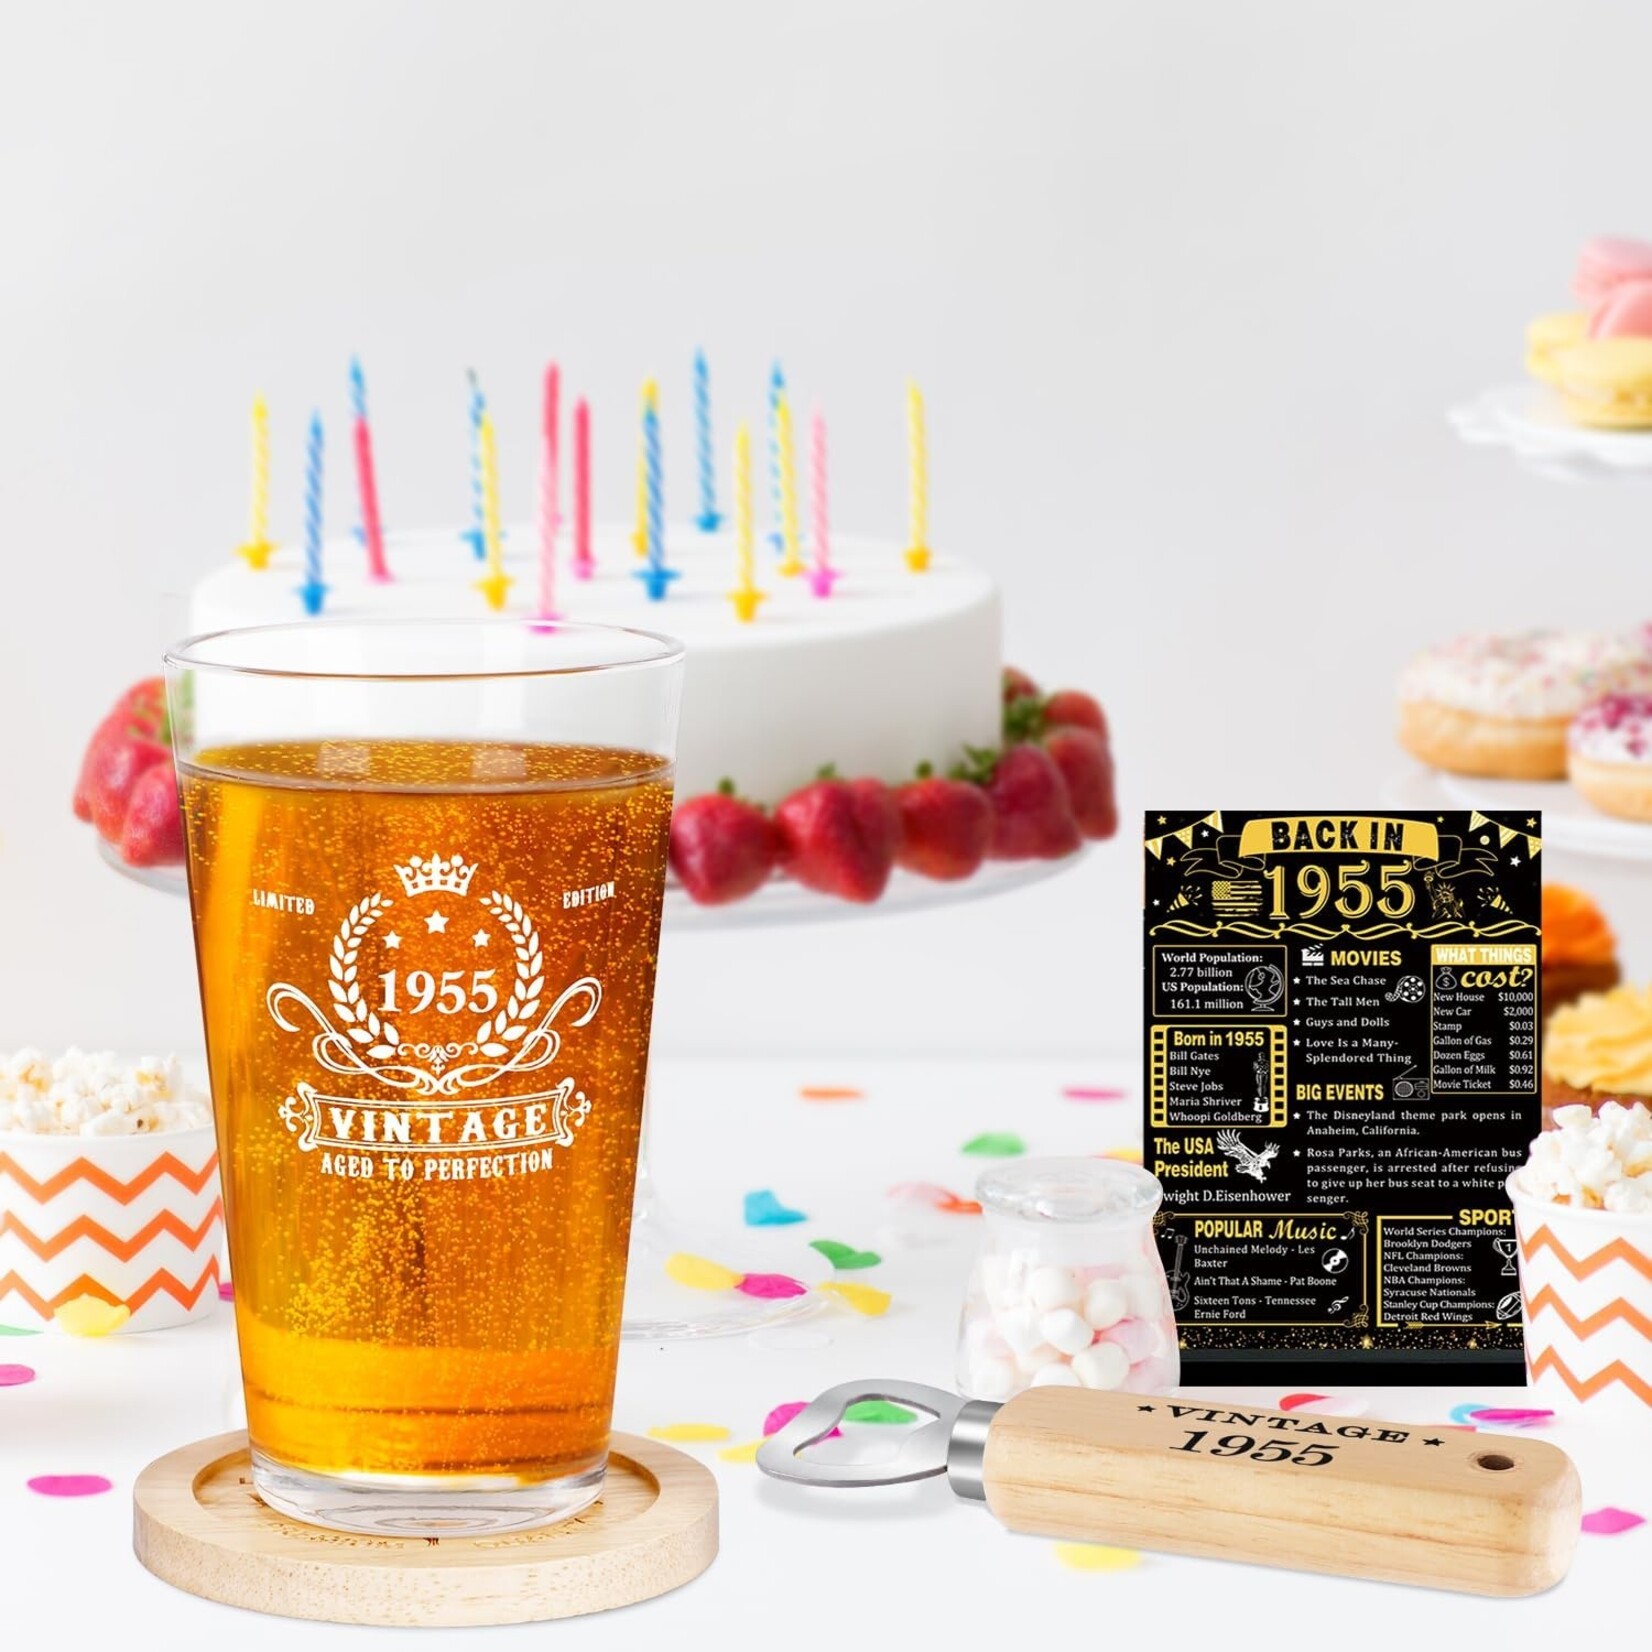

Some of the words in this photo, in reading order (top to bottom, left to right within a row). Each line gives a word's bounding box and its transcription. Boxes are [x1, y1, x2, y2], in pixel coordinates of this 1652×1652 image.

[1271, 820, 1359, 851] BACK
[1370, 822, 1404, 851] IN
[1263, 859, 1416, 920] 1955
[253, 888, 315, 915] LIMITED
[563, 881, 615, 909] EDITION
[1162, 952, 1196, 962] World
[1199, 952, 1263, 965] Population:
[1331, 950, 1402, 966] MOVIES
[1435, 947, 1477, 962] WHAT
[1480, 947, 1532, 962] THINGS
[1170, 967, 1194, 977] 2.77
[1197, 967, 1232, 977] billion
[1460, 966, 1534, 988] cost?
[1306, 976, 1327, 985] The
[1331, 976, 1349, 985] Sea
[1353, 976, 1386, 985] Chase
[377, 969, 497, 1014] 1955
[1162, 982, 1177, 992] US
[1180, 982, 1243, 994] Population:
[1306, 997, 1327, 1006] The
[1331, 997, 1352, 1006] Tall
[1356, 997, 1379, 1006] Men
[1433, 992, 1454, 1001] New
[1456, 992, 1484, 1001] House
[1498, 992, 1533, 1002] $10,000
[1171, 999, 1200, 1009] 161.1
[1205, 999, 1243, 1009] million
[1434, 1007, 1454, 1016] New
[1456, 1007, 1472, 1016] Car
[1504, 1007, 1533, 1016] $2,000
[1306, 1018, 1333, 1029] Guys
[1337, 1017, 1357, 1026] and
[1361, 1017, 1389, 1026] Dolls
[1433, 1021, 1462, 1032] Stamp
[1509, 1021, 1533, 1031] $0.03
[1174, 1031, 1206, 1046] Born
[1210, 1031, 1222, 1046] in
[1225, 1031, 1264, 1046] 1955
[1306, 1038, 1334, 1047] Love
[1338, 1038, 1348, 1047] Is
[1362, 1038, 1398, 1049] Many-
[1433, 1036, 1462, 1045] Gallon
[1464, 1036, 1474, 1045] of
[1475, 1036, 1491, 1045] Gas
[1509, 1036, 1533, 1045] $0.29
[1170, 1051, 1187, 1060] Bill
[1190, 1051, 1219, 1060] Gates
[1306, 1053, 1373, 1064] Splendored
[1377, 1053, 1412, 1064] Thing
[1434, 1051, 1461, 1059] Dozen
[1464, 1051, 1485, 1062] Eggs
[1509, 1050, 1532, 1060] $0.61
[1170, 1066, 1187, 1075] Bill
[1191, 1067, 1211, 1078] Nye
[1433, 1065, 1462, 1074] Gallon
[1464, 1065, 1474, 1074] of
[1476, 1065, 1495, 1074] Milk
[1509, 1065, 1533, 1074] $0.92
[1169, 1082, 1198, 1091] Steve
[1201, 1082, 1223, 1092] Jobs
[1433, 1080, 1461, 1088] Movie
[1463, 1080, 1491, 1088] Ticket
[1509, 1079, 1533, 1089] $0.46
[1296, 1084, 1321, 1100] BIG
[1326, 1084, 1384, 1100] EVENTS
[1170, 1097, 1200, 1106] Maria
[1203, 1097, 1242, 1106] Shriver
[1169, 1112, 1210, 1123] Whoopi
[1214, 1112, 1262, 1123] Goldberg
[1307, 1111, 1327, 1120] The
[1334, 1111, 1395, 1122] Disneyland
[1401, 1111, 1435, 1119] theme
[1442, 1111, 1467, 1122] park
[1472, 1113, 1505, 1122] opens
[1511, 1111, 1521, 1119] in
[329, 1104, 547, 1144] VINTAGE
[1307, 1126, 1358, 1135] Anaheim,
[1362, 1126, 1419, 1135] California.
[1154, 1137, 1180, 1154] The
[1184, 1137, 1214, 1154] USA
[1307, 1148, 1334, 1157] Rosa
[1339, 1148, 1374, 1158] Parks,
[1395, 1148, 1497, 1157] African-American
[1502, 1148, 1522, 1157] bus
[321, 1152, 373, 1179] AGED
[383, 1157, 414, 1181] TO
[424, 1148, 553, 1180] PERFECTION
[1154, 1160, 1228, 1177] President
[1307, 1165, 1368, 1174] passenger,
[1374, 1164, 1383, 1172] is
[1388, 1163, 1436, 1172] arrested
[1441, 1163, 1469, 1172] after
[1322, 1179, 1345, 1189] give
[1349, 1181, 1363, 1190] up
[1366, 1178, 1385, 1187] her
[1388, 1178, 1408, 1187] bus
[1462, 1178, 1494, 1187] white
[1164, 1189, 1199, 1205] wight
[1307, 1196, 1348, 1205] senger.
[1459, 1209, 1514, 1225] SPOR
[1195, 1220, 1263, 1238] POPULAR
[1269, 1219, 1336, 1240] Music
[1383, 1227, 1414, 1235] World
[1417, 1227, 1446, 1235] Series
[1448, 1227, 1506, 1238] Champions:
[1384, 1239, 1428, 1249] Brooklyn
[1431, 1240, 1471, 1249] Dodgers
[1194, 1245, 1247, 1254] Unchained
[1251, 1245, 1288, 1256] Melody
[1298, 1245, 1315, 1253] Les
[1384, 1252, 1404, 1260] NFL
[1406, 1252, 1463, 1262] Champions:
[1195, 1259, 1227, 1268] Baxter
[1383, 1264, 1431, 1272] Cleveland
[1434, 1264, 1471, 1272] Browns
[1194, 1277, 1216, 1285] Ain't
[1218, 1276, 1239, 1285] That
[1242, 1277, 1249, 1285] A
[1251, 1276, 1282, 1285] Shame
[1290, 1276, 1305, 1285] Pat
[1307, 1276, 1337, 1285] Boone
[1384, 1276, 1405, 1284] NBA
[1408, 1276, 1465, 1286] Champions:
[1384, 1288, 1427, 1298] Syracuse
[1430, 1288, 1476, 1296] Nationals
[1194, 1296, 1229, 1305] Sixteen
[1232, 1296, 1256, 1305] Tons
[1265, 1296, 1316, 1305] Tennessee
[1383, 1300, 1418, 1310] Stanley
[1420, 1300, 1438, 1310] Cup
[1440, 1300, 1495, 1310] Champions:
[1195, 1310, 1220, 1319] Ernie
[1223, 1310, 1245, 1318] Ford
[1384, 1313, 1418, 1321] Detroit
[1421, 1312, 1439, 1321] Red
[1442, 1313, 1473, 1322] Wings
[1167, 1405, 1410, 1444] VINTAGE
[1169, 1430, 1340, 1466] 1955
